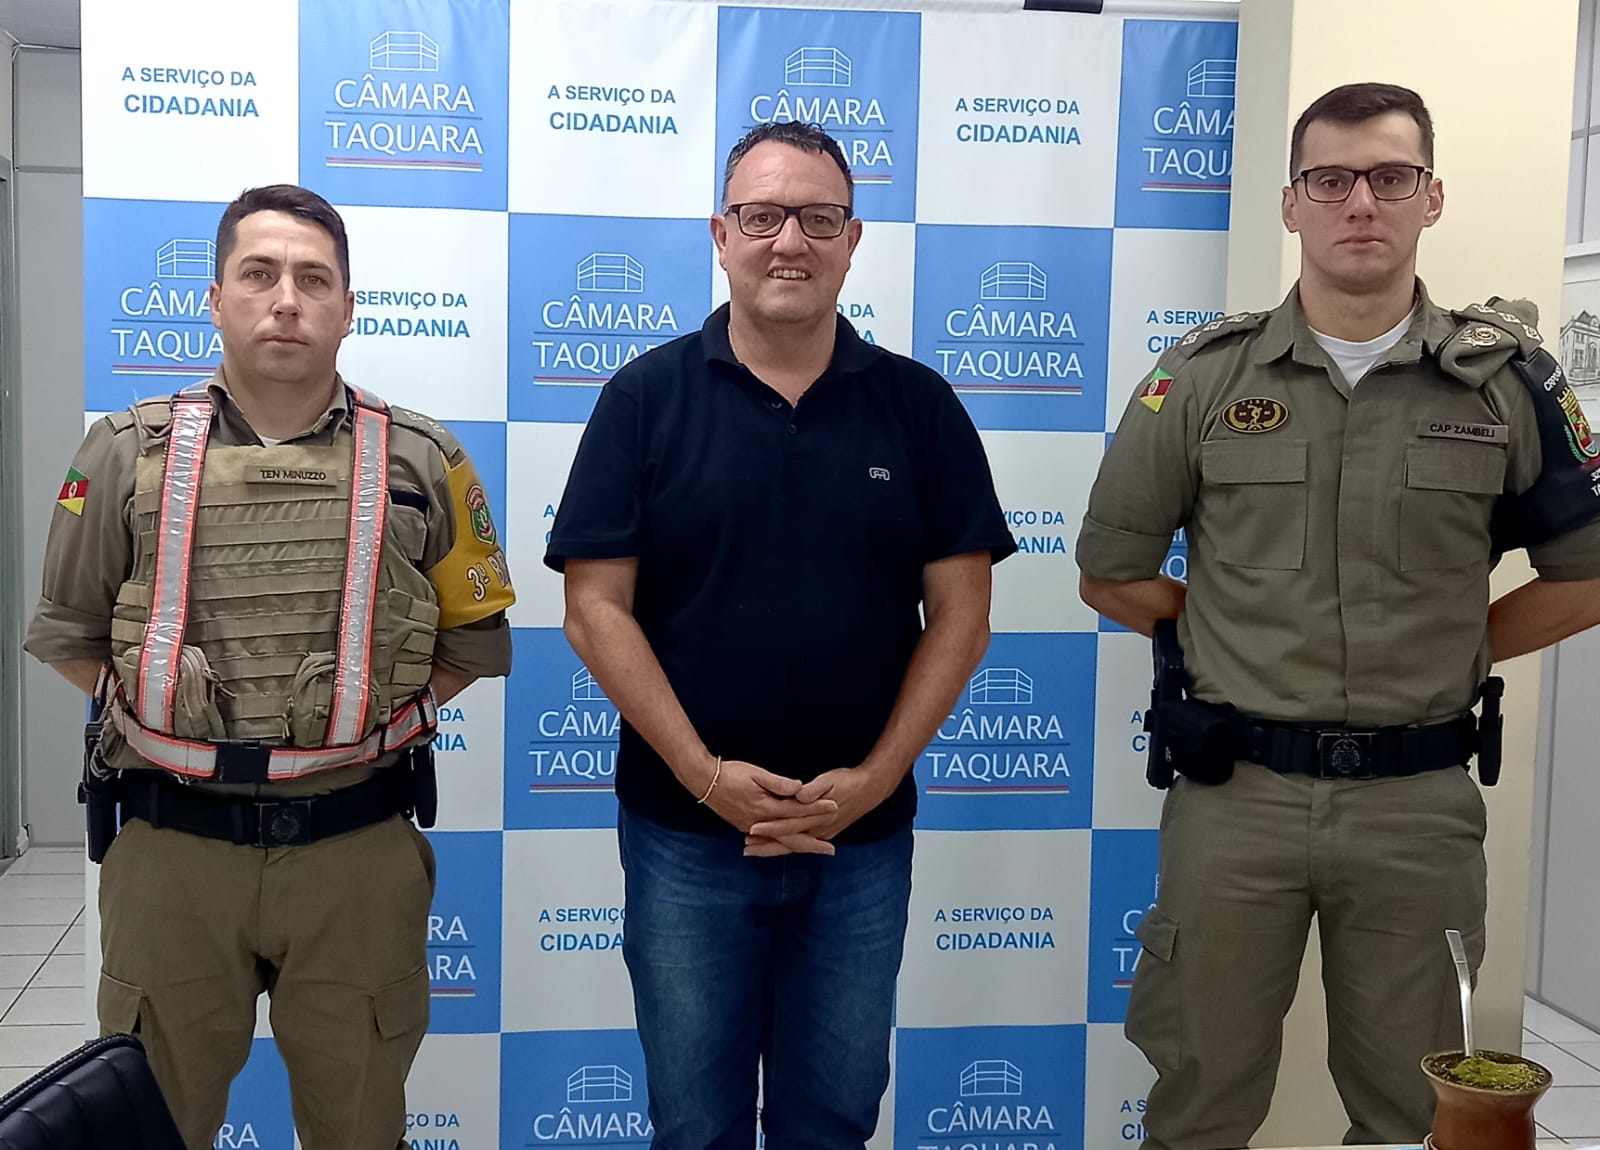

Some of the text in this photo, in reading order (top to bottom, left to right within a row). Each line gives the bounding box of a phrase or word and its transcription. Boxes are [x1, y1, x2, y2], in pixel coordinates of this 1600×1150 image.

[122, 67, 256, 87] A SERVIÇO DA
[335, 74, 475, 112] CÂMARA
[548, 85, 675, 106] A SERVIÇO DA
[124, 94, 259, 117] CIDADANIA
[750, 89, 886, 125] CÂMARA
[955, 98, 1080, 116] A SERVIÇO DA
[550, 112, 678, 134] CIDADANIA
[1153, 101, 1234, 135] CÂMA
[325, 121, 484, 155] TAQUARA
[956, 124, 1081, 145] CIDADANIA
[1142, 148, 1232, 179] TAQU
[121, 281, 210, 316] CÂMA
[356, 291, 468, 310] SERVIÇO DA
[542, 295, 679, 331] CÂMARA
[850, 303, 875, 318] DA
[945, 303, 1077, 338] CÂMARA
[1146, 310, 1159, 324] A
[110, 329, 224, 362] TAQUA
[532, 341, 657, 373] TAQUA
[936, 349, 1084, 380] TAQUARA
[1430, 423, 1495, 438] CAP ZAMBELI
[260, 469, 326, 480] TEN MINUZZO
[543, 504, 556, 517] A
[1042, 511, 1064, 525] DA
[440, 708, 465, 721] DA
[539, 704, 621, 737] CÂMA
[937, 708, 1064, 740] CÂMARA
[1131, 710, 1143, 723] A
[528, 750, 616, 780] TAQU
[925, 753, 1071, 783] TAQUARA
[539, 909, 551, 922] A
[935, 907, 1054, 924] A SERVIÇO DA
[540, 933, 624, 952] CIDADA
[936, 932, 1056, 951] CIDADANIA
[927, 1101, 1055, 1133] CÂMARA
[1120, 1100, 1132, 1113] A
[435, 1113, 460, 1127] DA
